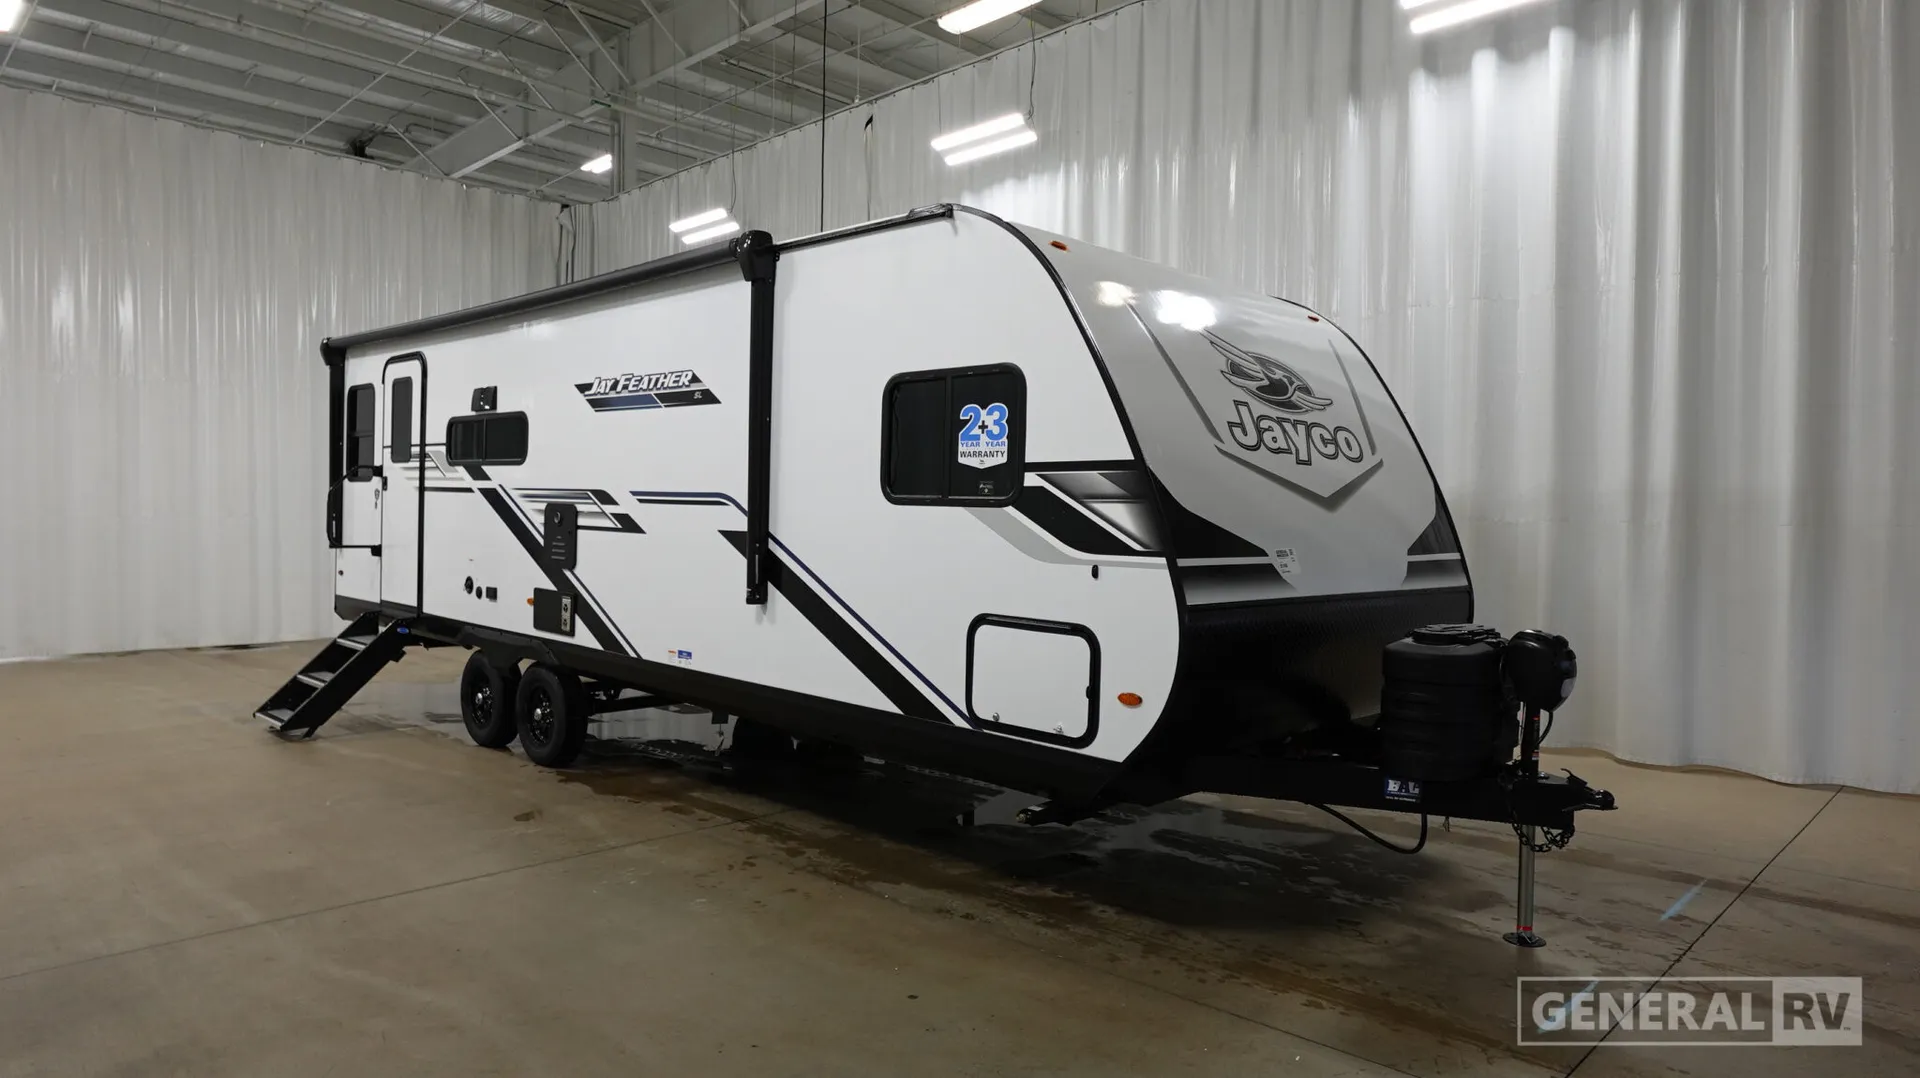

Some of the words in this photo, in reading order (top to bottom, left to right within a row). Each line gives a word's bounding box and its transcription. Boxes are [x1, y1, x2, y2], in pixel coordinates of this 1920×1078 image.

[583, 376, 619, 397] JAY
[616, 369, 694, 393] FEATHER
[1227, 400, 1364, 466] Jayco
[960, 450, 1006, 458] WARRANTY
